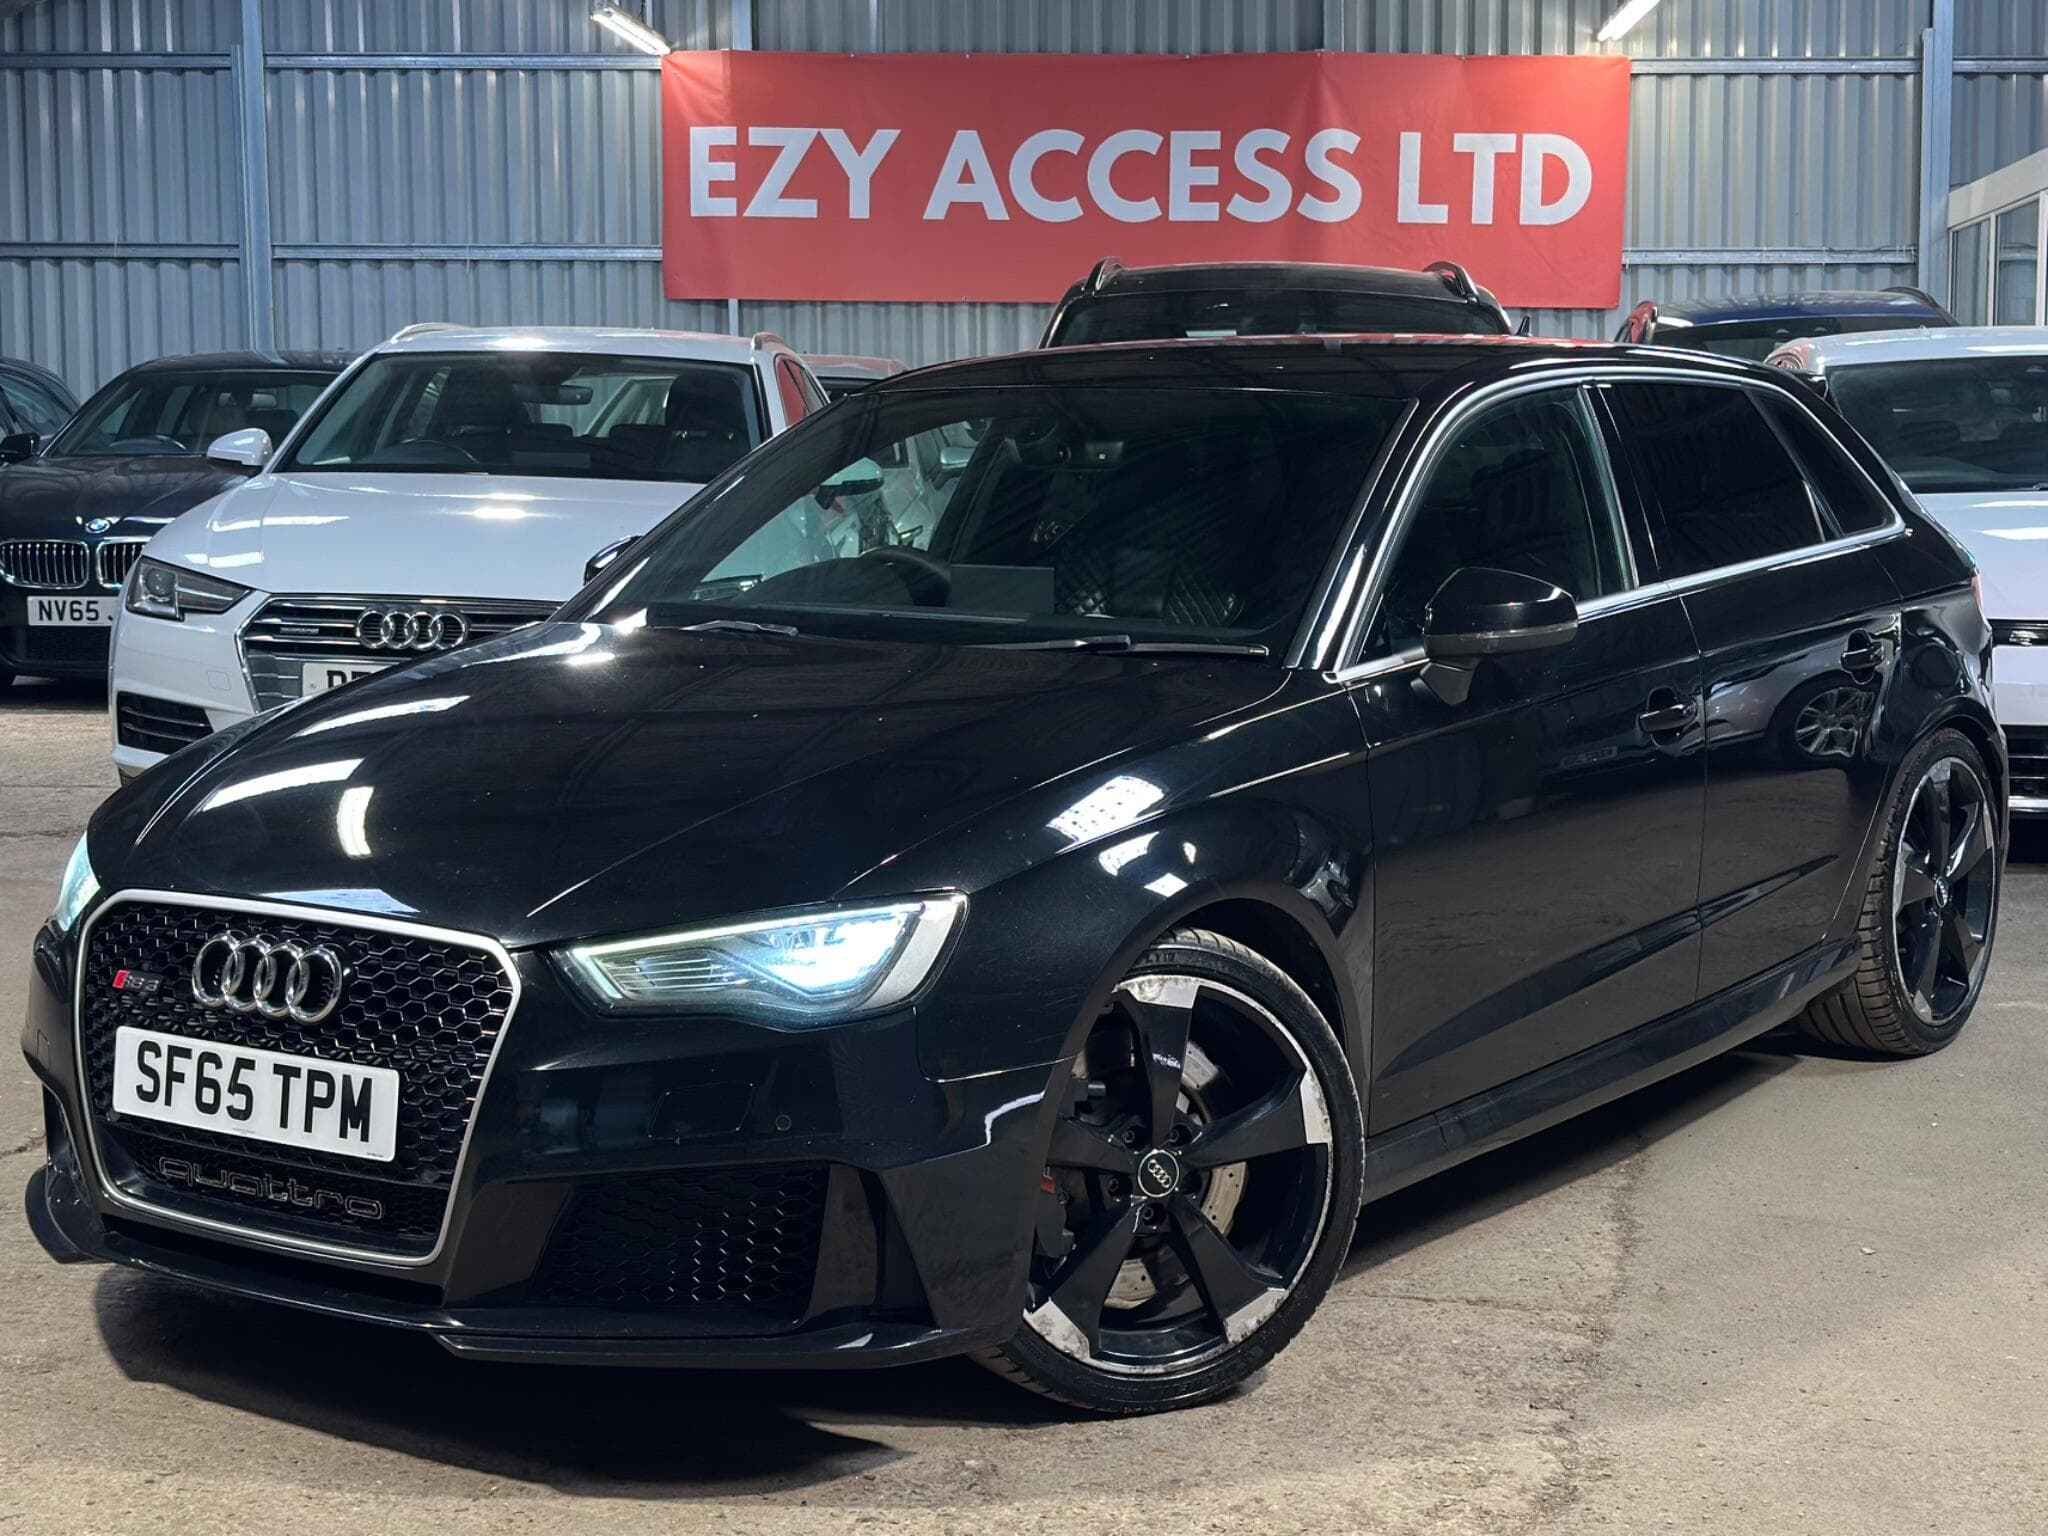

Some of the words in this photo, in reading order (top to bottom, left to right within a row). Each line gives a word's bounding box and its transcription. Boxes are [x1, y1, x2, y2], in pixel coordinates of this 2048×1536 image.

[689, 126, 901, 219] EZY
[923, 128, 1363, 223] ACCESS
[1397, 131, 1594, 226] LTD
[38, 599, 99, 621] NV65
[136, 1040, 257, 1121] SF65
[272, 1063, 373, 1143] TPM
[159, 1156, 385, 1220] quattro
